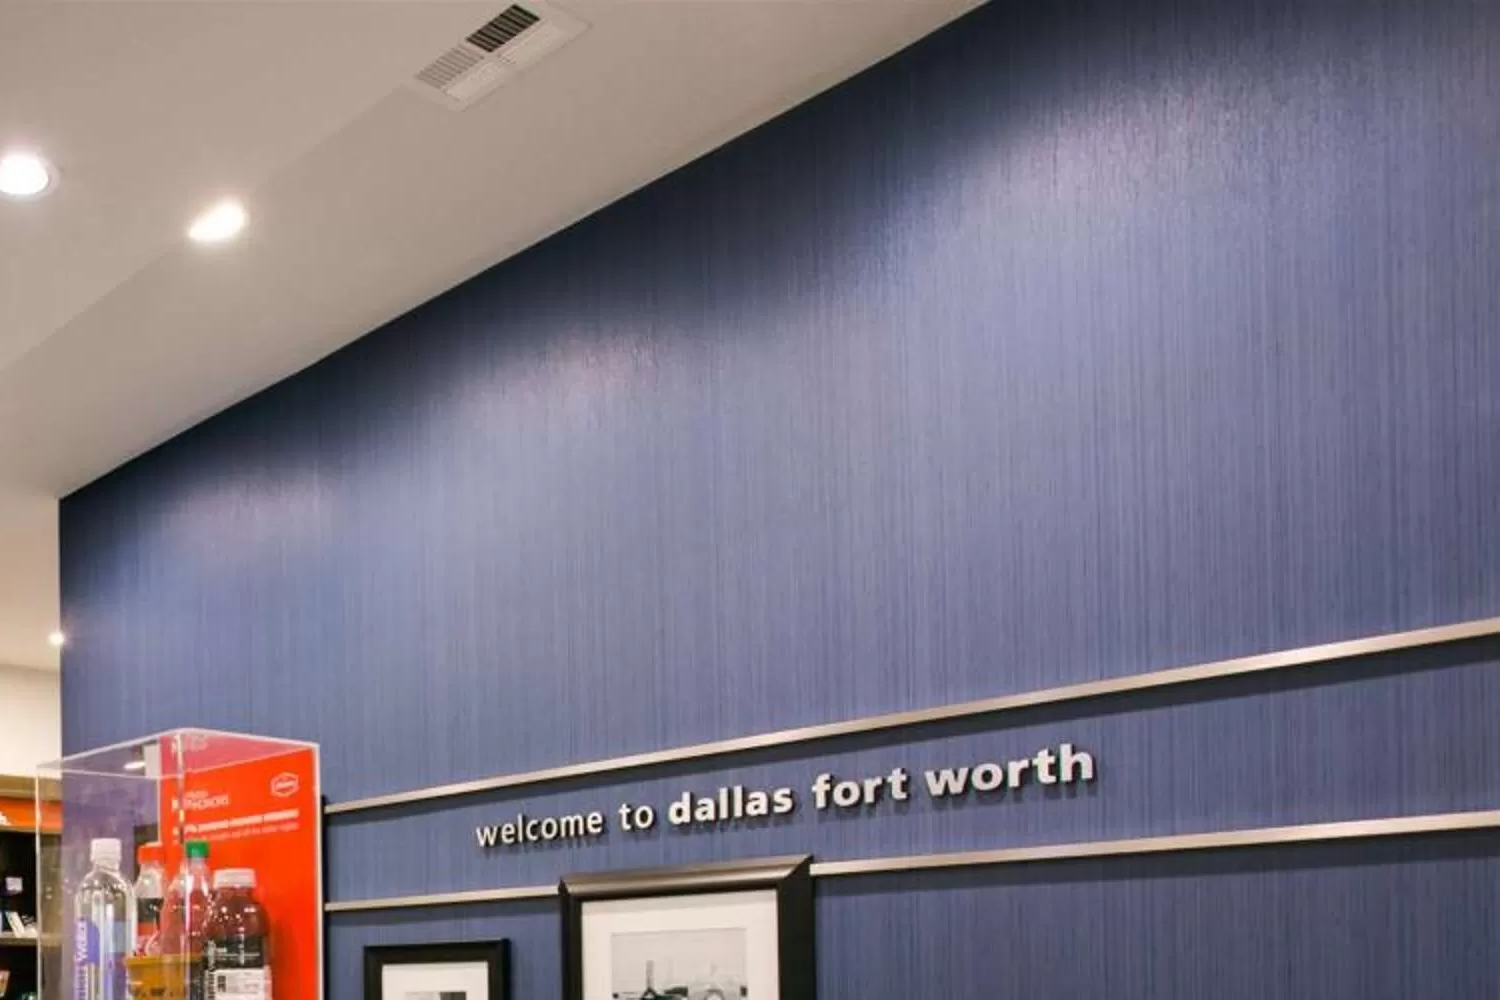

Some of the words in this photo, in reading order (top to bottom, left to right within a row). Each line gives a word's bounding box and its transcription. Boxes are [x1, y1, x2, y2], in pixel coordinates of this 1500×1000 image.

[476, 810, 604, 847] welcome
[618, 803, 654, 831] to
[668, 784, 794, 826] dallas
[812, 768, 908, 809] fort
[924, 743, 1095, 797] worth
